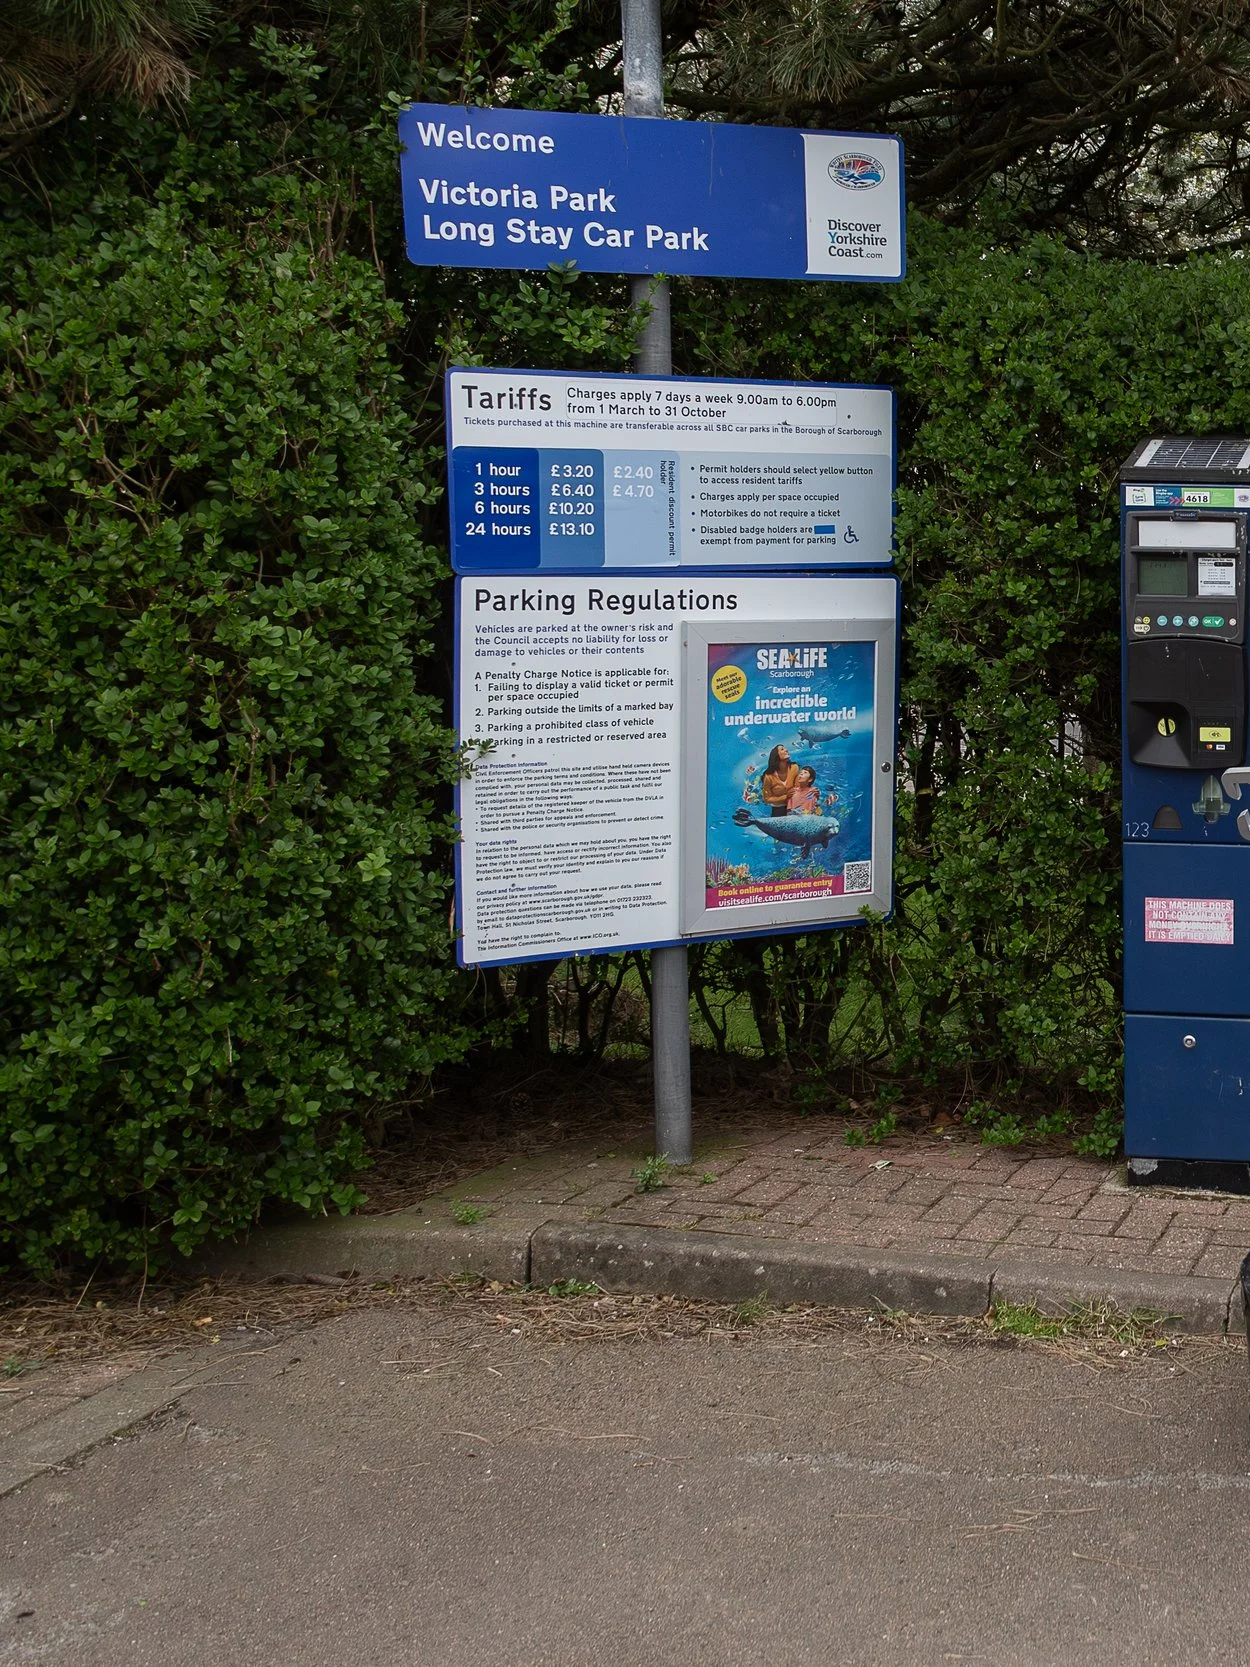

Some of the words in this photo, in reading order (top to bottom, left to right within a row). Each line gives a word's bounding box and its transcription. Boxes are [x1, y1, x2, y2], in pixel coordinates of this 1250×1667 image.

[417, 121, 554, 154] Welcome
[419, 178, 538, 209] Victoria
[550, 185, 616, 212] Park
[423, 214, 494, 247] Long
[506, 218, 573, 250] Stay
[583, 221, 634, 247] Car
[646, 224, 709, 251] Park
[827, 219, 881, 232] Discover
[828, 231, 887, 246] Yorkshire
[461, 384, 551, 411] Tariffs
[567, 387, 616, 401] Charges
[619, 390, 652, 403] apply
[655, 390, 662, 401] 7
[665, 391, 691, 404] days
[694, 394, 701, 403] a
[704, 393, 733, 404] week
[736, 393, 778, 405] 9.00am
[781, 395, 793, 406] to
[796, 395, 837, 409] 6.00pm
[567, 402, 595, 414] from
[599, 403, 603, 414] 1
[608, 403, 645, 415] March
[648, 405, 661, 416] to
[664, 406, 677, 416] 31
[680, 406, 726, 418] October
[463, 416, 495, 425] Tickets
[497, 418, 542, 427] purchased
[544, 419, 553, 427] at
[555, 419, 571, 427] this
[573, 420, 608, 429] machine
[625, 421, 674, 430] transferable
[703, 423, 714, 431] all
[715, 423, 733, 432] SBC
[749, 425, 770, 434] parks
[771, 425, 779, 433] in
[780, 424, 793, 434] the
[795, 425, 826, 436] Borough
[827, 426, 835, 435] of
[837, 427, 882, 437] Scarborough
[475, 462, 481, 475] 1
[489, 462, 521, 476] hour
[699, 464, 727, 473] Permit
[729, 464, 761, 473] holders
[763, 465, 791, 474] should
[793, 465, 817, 474] select
[819, 466, 845, 476] yellow
[846, 466, 873, 475] button
[668, 460, 676, 494] Resident
[699, 475, 709, 484] to
[741, 476, 775, 485] resident
[777, 476, 803, 485] tariffs
[474, 481, 484, 495] 3
[490, 482, 530, 496] hours
[699, 492, 735, 502] Charges
[736, 492, 760, 502] apply
[762, 494, 776, 502] per
[777, 494, 802, 502] space
[803, 493, 839, 502] occupied
[1185, 495, 1208, 504] 4618
[474, 500, 484, 514] 6
[490, 501, 530, 515] hours
[548, 501, 594, 515] £10.20
[668, 496, 676, 529] discount
[700, 509, 748, 517] Motorbikes
[750, 509, 761, 517] do
[763, 509, 777, 517] not
[779, 508, 808, 518] require
[817, 508, 840, 517] ticket
[465, 522, 486, 535] 24
[491, 522, 531, 535] hours
[549, 522, 594, 535] £13.10
[700, 525, 737, 534] Disabled
[739, 525, 765, 535] badge
[767, 525, 797, 534] holders
[668, 531, 676, 556] permit
[699, 536, 731, 546] exempt
[733, 536, 753, 545] from
[755, 536, 790, 546] payment
[792, 535, 804, 544] for
[806, 535, 836, 545] parking
[475, 588, 575, 615] Parking
[588, 588, 737, 615] Regulations
[474, 624, 515, 634] Vehicles
[517, 625, 533, 633] are
[535, 623, 568, 634] parked
[570, 623, 580, 632] at
[583, 623, 598, 632] the
[600, 624, 636, 632] owner's
[638, 623, 655, 631] risk
[657, 623, 673, 631] and
[757, 648, 791, 670] SEA
[474, 671, 482, 680] A
[485, 670, 521, 681] Penalty
[523, 669, 558, 680] Charge
[561, 669, 592, 678] Notice
[594, 668, 602, 677] is
[604, 667, 651, 678] applicable
[653, 667, 669, 676] for:
[770, 669, 814, 678] Scarborough
[716, 676, 742, 690] adorable
[721, 684, 740, 694] rescue
[772, 686, 800, 694] Explore
[725, 690, 740, 700] seals
[756, 695, 827, 709] incredible
[724, 709, 810, 726] underwater
[814, 706, 857, 721] world
[1125, 821, 1149, 838] 123
[718, 887, 738, 896] Book
[739, 884, 763, 894] online
[765, 883, 773, 891] to
[774, 881, 811, 893] guarantee
[812, 878, 832, 889] entry
[1148, 900, 1167, 909] THIS
[1169, 901, 1207, 910] MACHINE
[1209, 902, 1231, 910] DOES
[1153, 911, 1170, 919] NOT
[1148, 930, 1157, 939] IT
[1158, 931, 1166, 939] IS
[1169, 931, 1204, 940] EMPTIED
